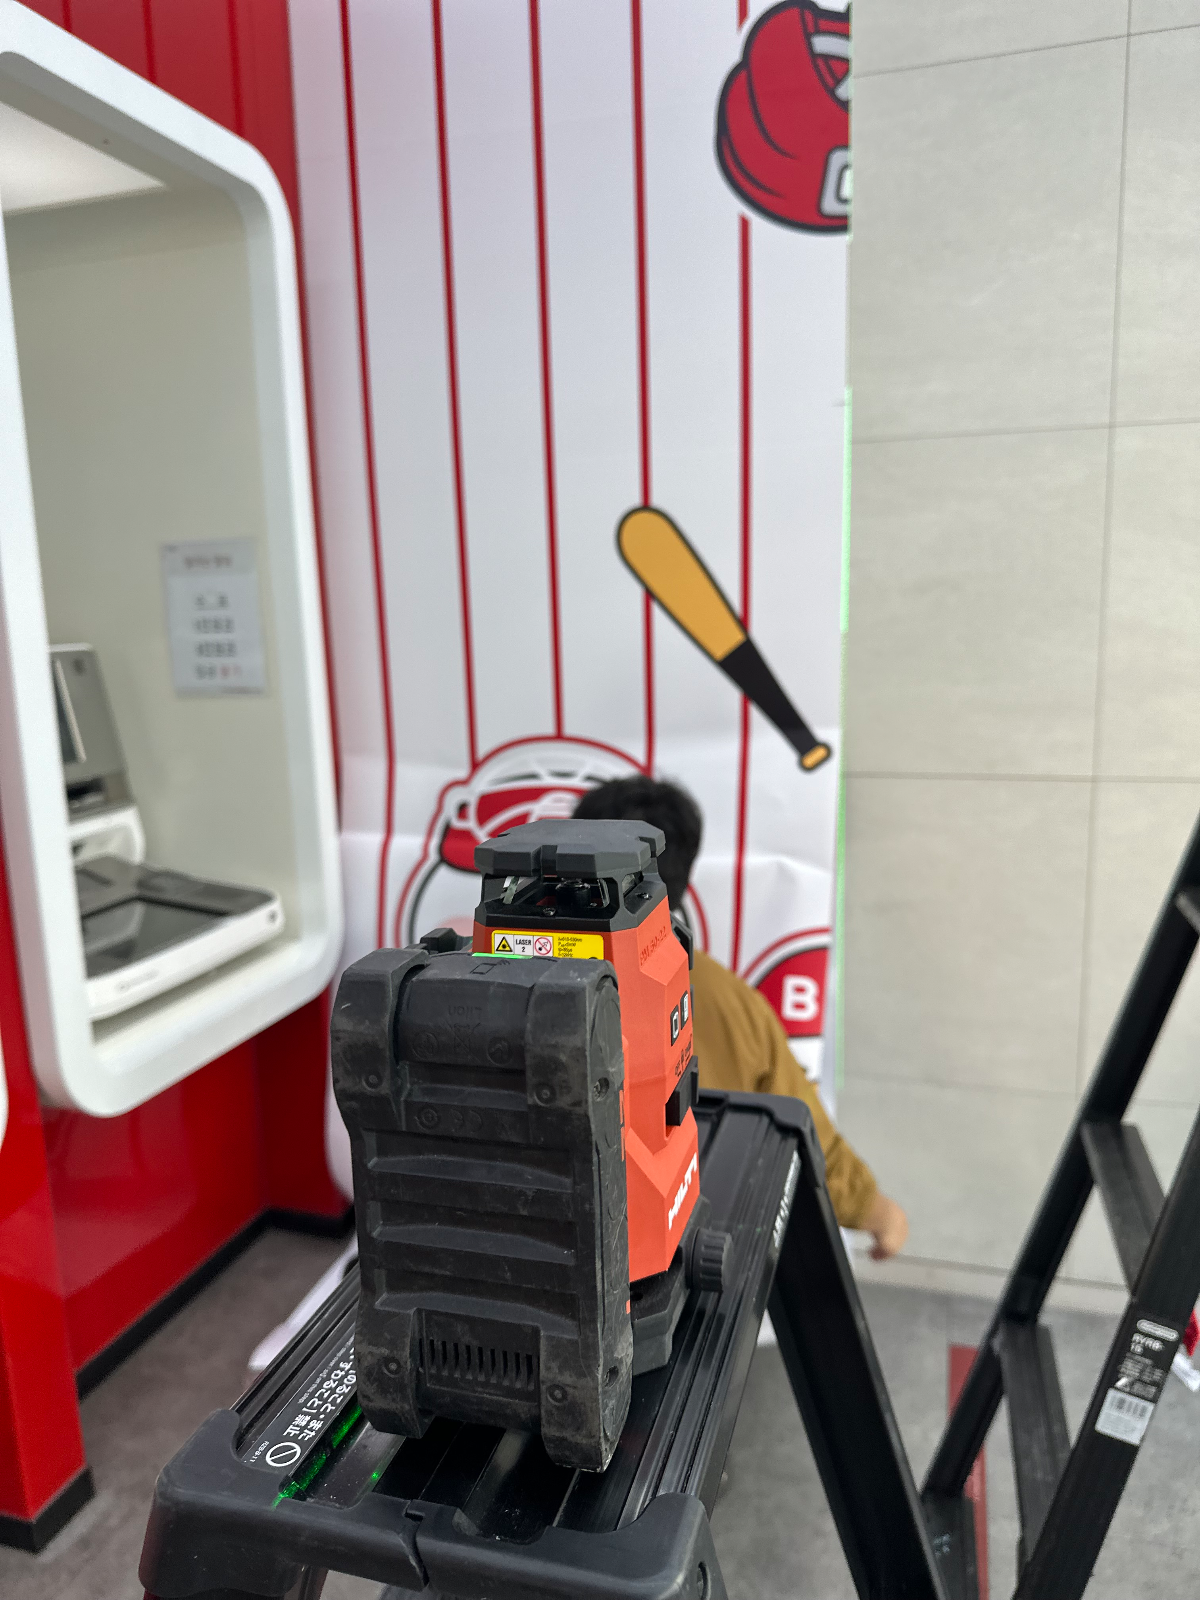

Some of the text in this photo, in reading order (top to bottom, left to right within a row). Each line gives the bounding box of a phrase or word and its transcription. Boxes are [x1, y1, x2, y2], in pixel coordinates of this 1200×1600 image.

[515, 938, 532, 946] LASER
[781, 974, 819, 1022] B
[668, 1152, 697, 1230] HILTI
